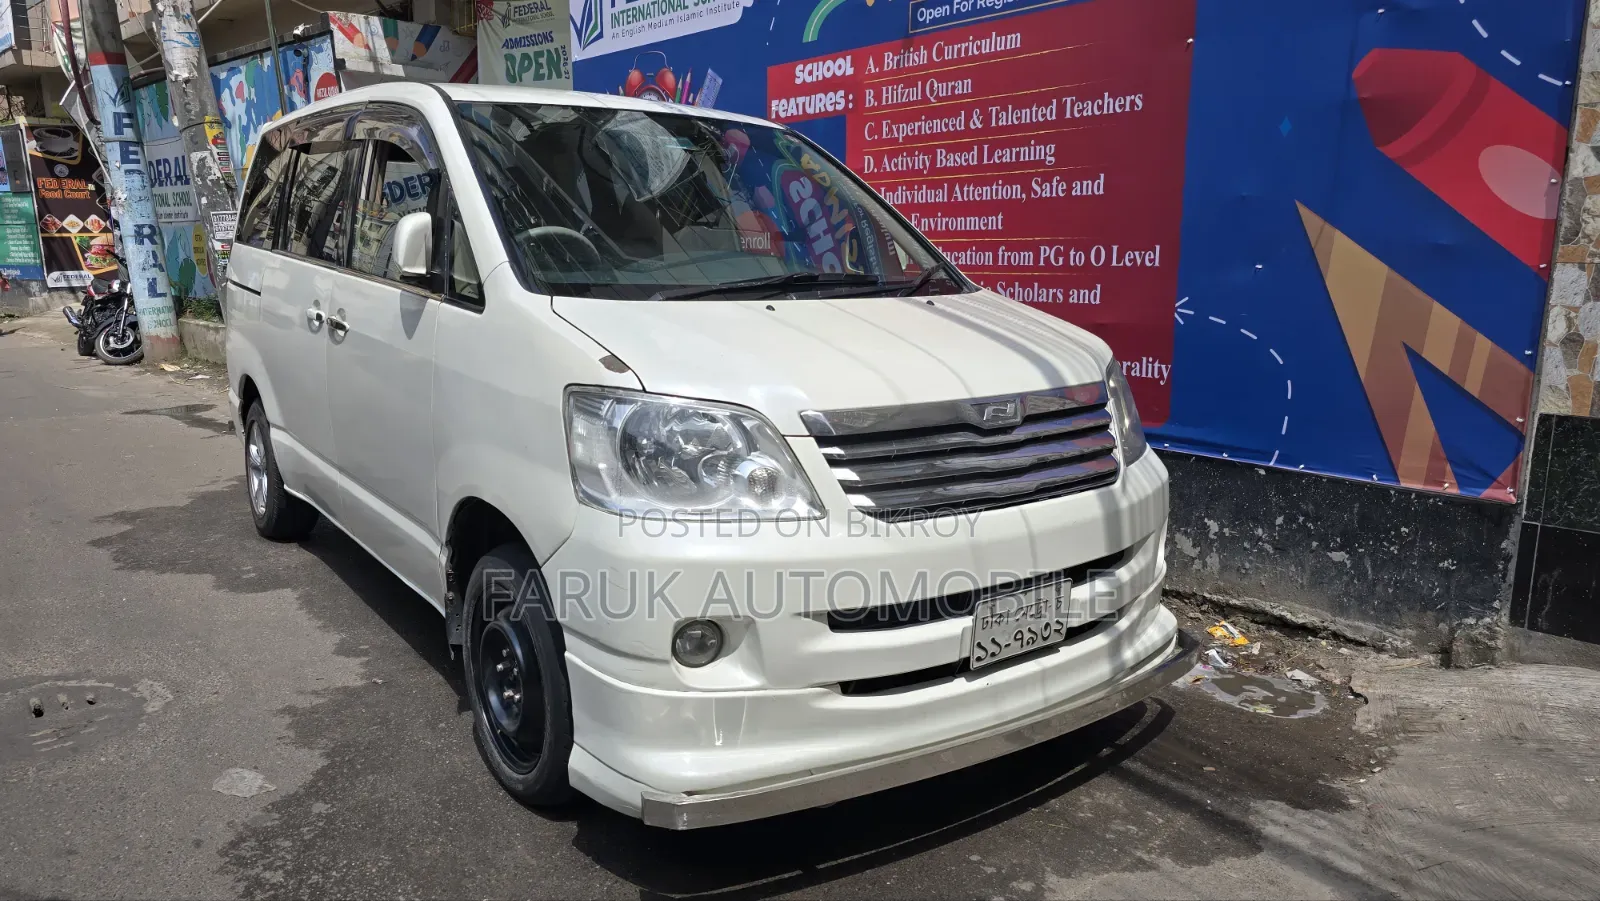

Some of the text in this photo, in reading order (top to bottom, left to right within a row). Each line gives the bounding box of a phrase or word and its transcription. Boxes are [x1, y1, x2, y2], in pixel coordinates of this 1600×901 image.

[513, 0, 552, 17] FEDERAL
[611, 0, 689, 29] INTERNATIONAL
[611, 32, 620, 40] An
[621, 24, 646, 38] English
[648, 18, 675, 31] Medium
[677, 10, 704, 23] Islamic
[706, 1, 740, 16] Institute
[917, 5, 950, 23] Open
[953, 0, 974, 14] For
[501, 31, 554, 49] ADMISSIONS
[865, 30, 1021, 75] A. British Curriculum
[504, 47, 563, 84] OPEN
[561, 45, 570, 80] 2026-27
[794, 55, 854, 85] SCHOOL
[864, 78, 973, 108] B. Hifzul Quran
[864, 91, 1144, 142] C. Experienced & Talented Teachers
[148, 155, 191, 188] DERAL
[863, 140, 1056, 174] D. Activity Based Learning
[37, 178, 88, 189] FEDERAL
[40, 190, 90, 199] Food Court
[880, 173, 1105, 205] Individual Attention, Safe and
[911, 211, 1004, 232] Environment
[938, 244, 1161, 267] ucation from PG to O Level
[996, 281, 1063, 304] Scholars
[1068, 284, 1102, 305] and
[1117, 356, 1171, 385] rality
